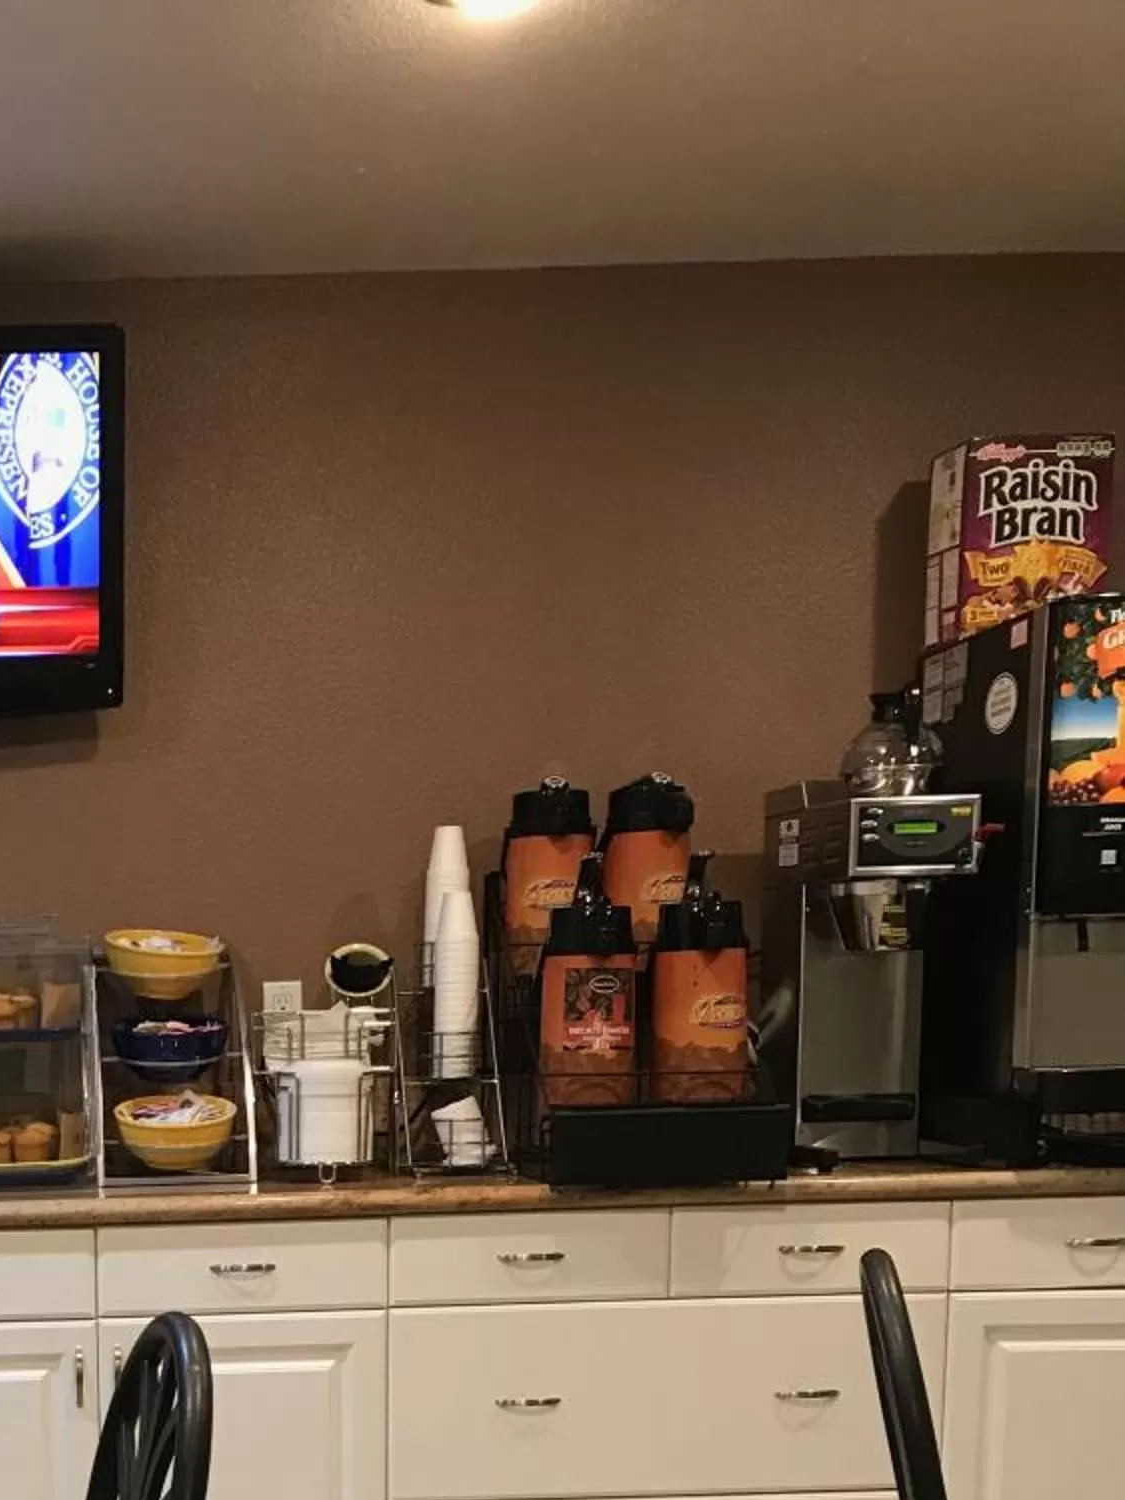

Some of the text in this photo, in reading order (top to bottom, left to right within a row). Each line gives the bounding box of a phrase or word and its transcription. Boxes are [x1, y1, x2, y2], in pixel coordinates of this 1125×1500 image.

[978, 457, 1098, 517] Raisin
[989, 503, 1086, 548] Bran
[979, 561, 1010, 575] Two
